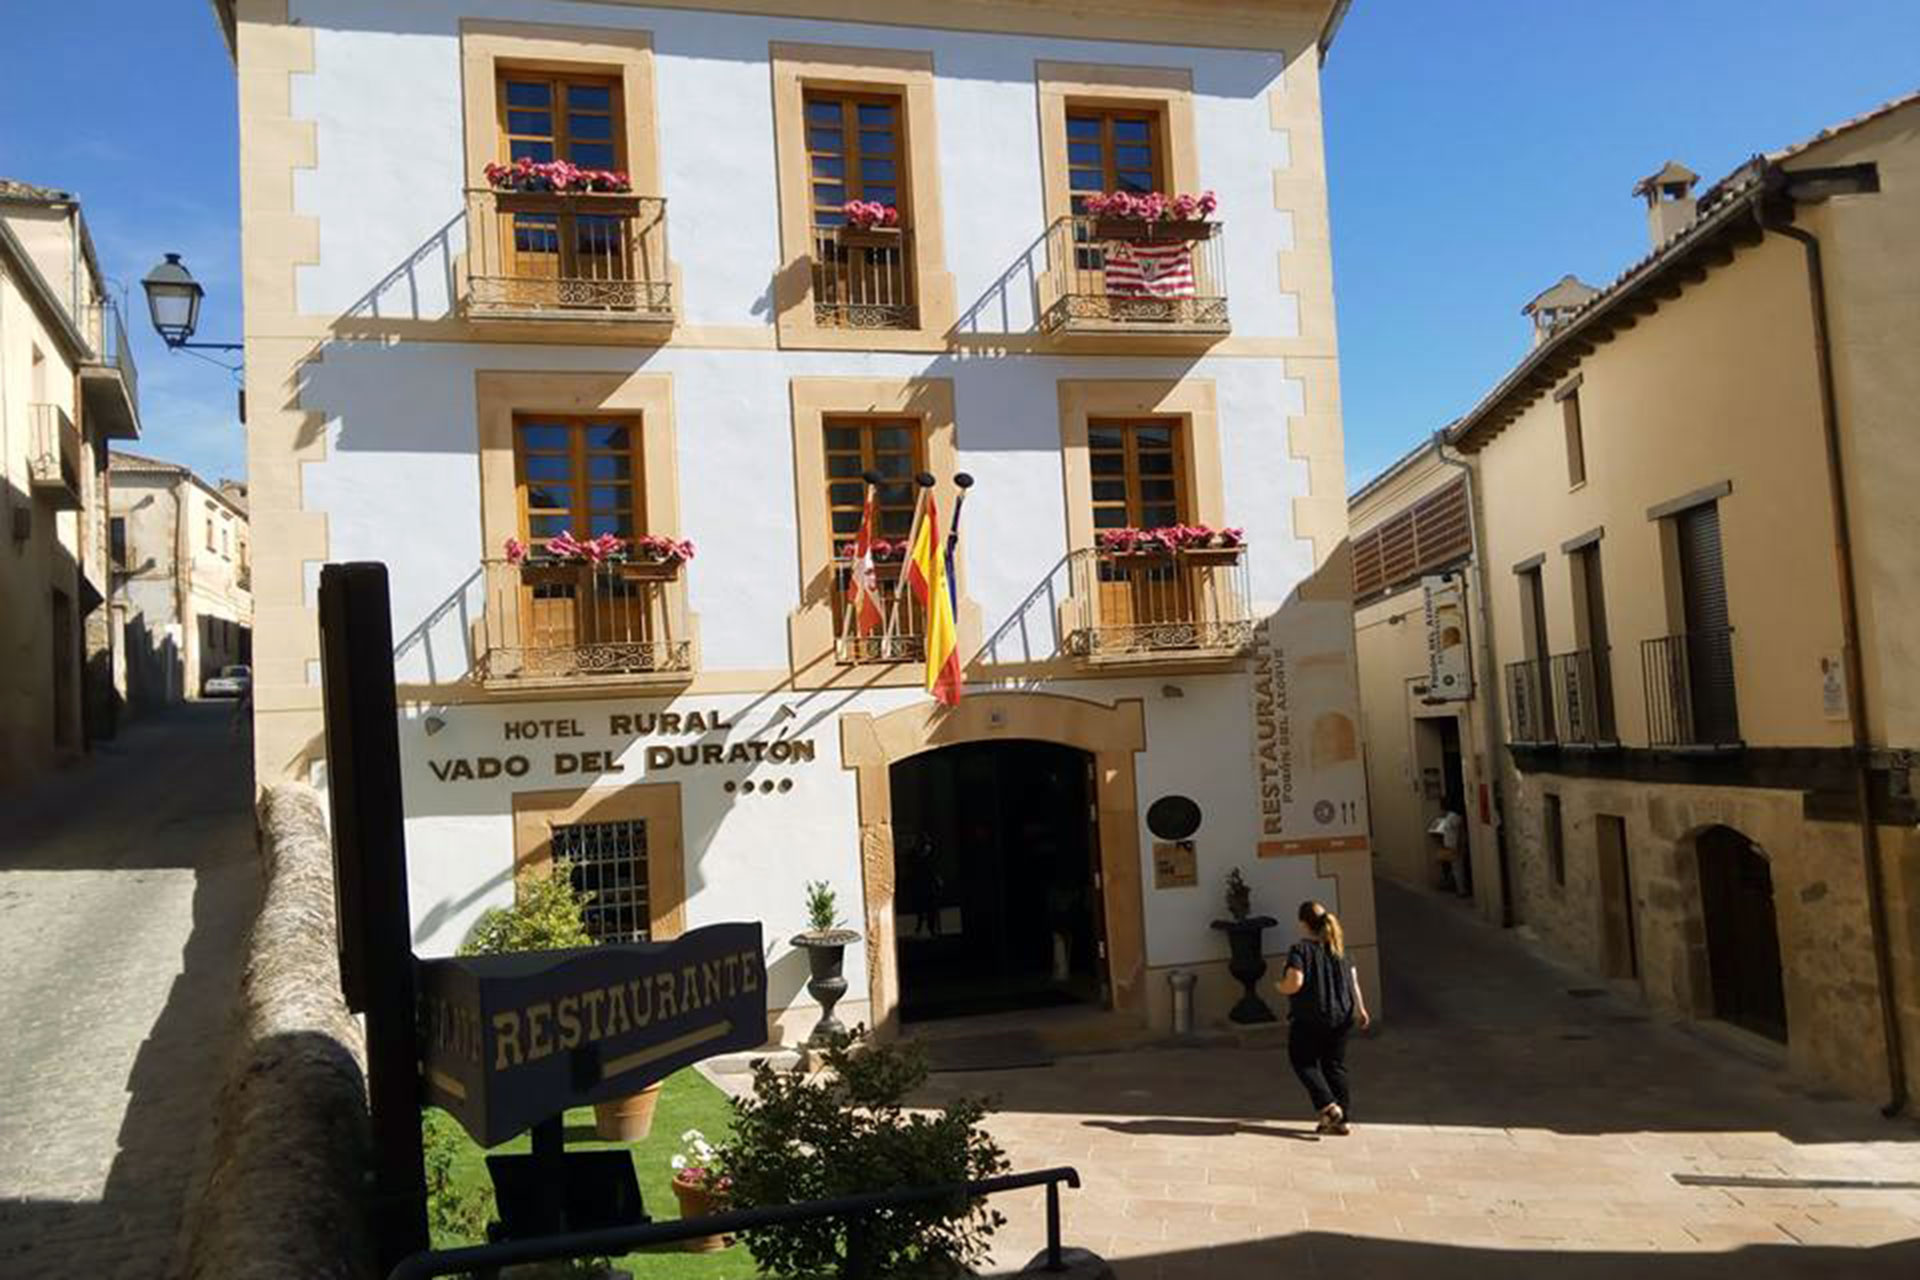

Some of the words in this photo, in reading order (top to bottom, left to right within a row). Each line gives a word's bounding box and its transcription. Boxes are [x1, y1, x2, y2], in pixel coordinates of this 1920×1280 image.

[428, 755, 530, 782] VADO
[554, 750, 624, 776] DEL
[647, 727, 816, 771] DURATÓN
[504, 719, 584, 740] HOTEL
[609, 709, 731, 736] RURAL
[1254, 618, 1282, 835] RESTAURANTE
[493, 951, 759, 1072] RESTAURANTE
